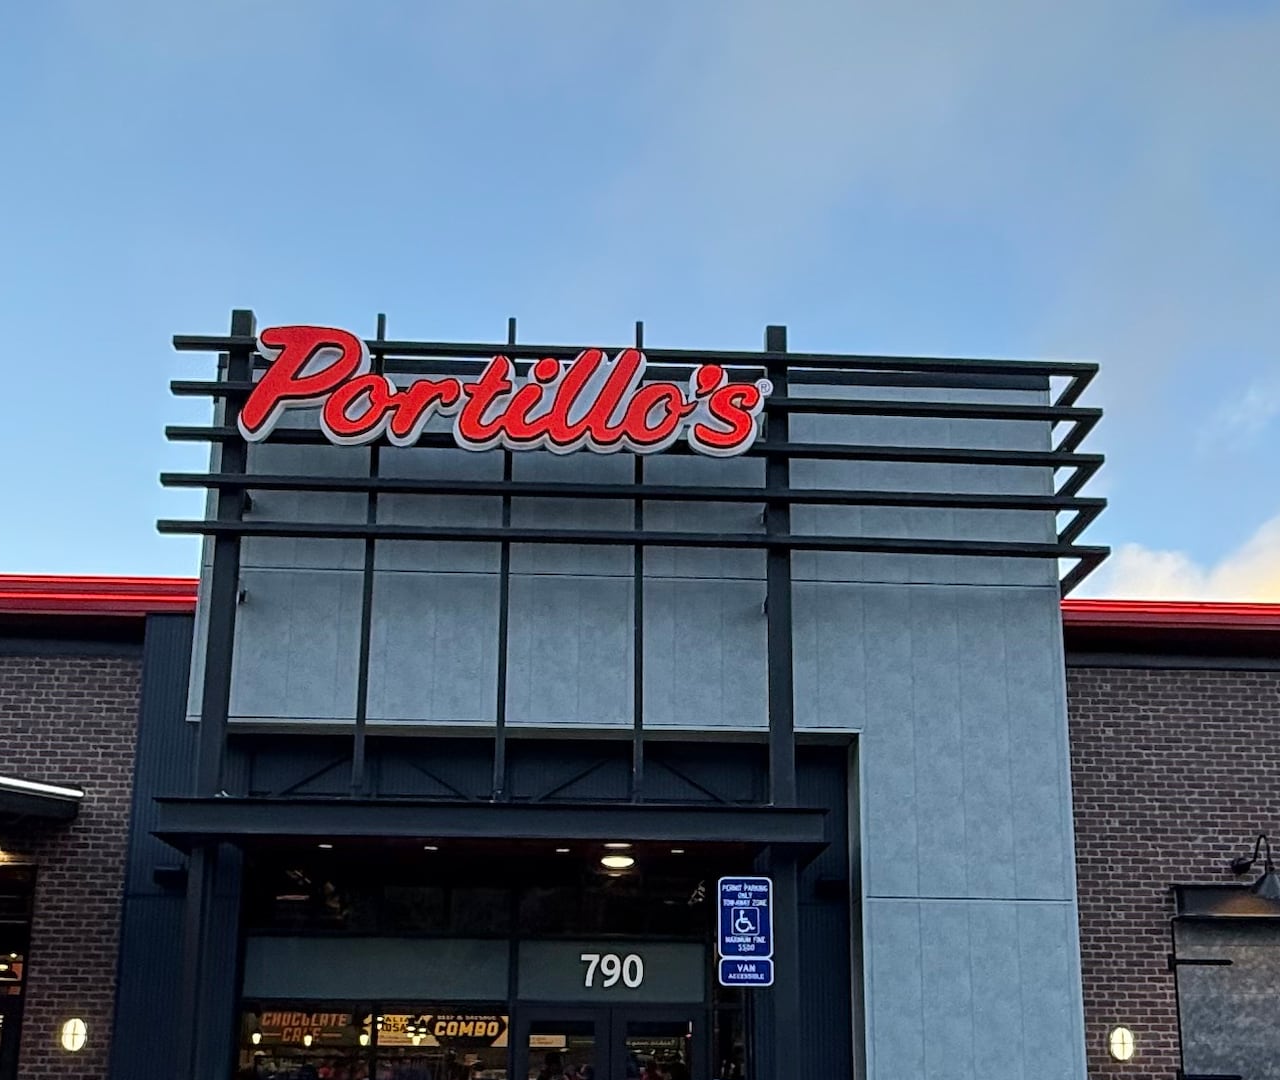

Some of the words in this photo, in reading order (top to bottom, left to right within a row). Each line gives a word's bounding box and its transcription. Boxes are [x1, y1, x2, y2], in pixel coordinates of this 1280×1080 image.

[238, 324, 762, 456] Portillo's
[581, 954, 644, 988] 790
[737, 964, 756, 973] VAN
[434, 1021, 499, 1037] COMBO
